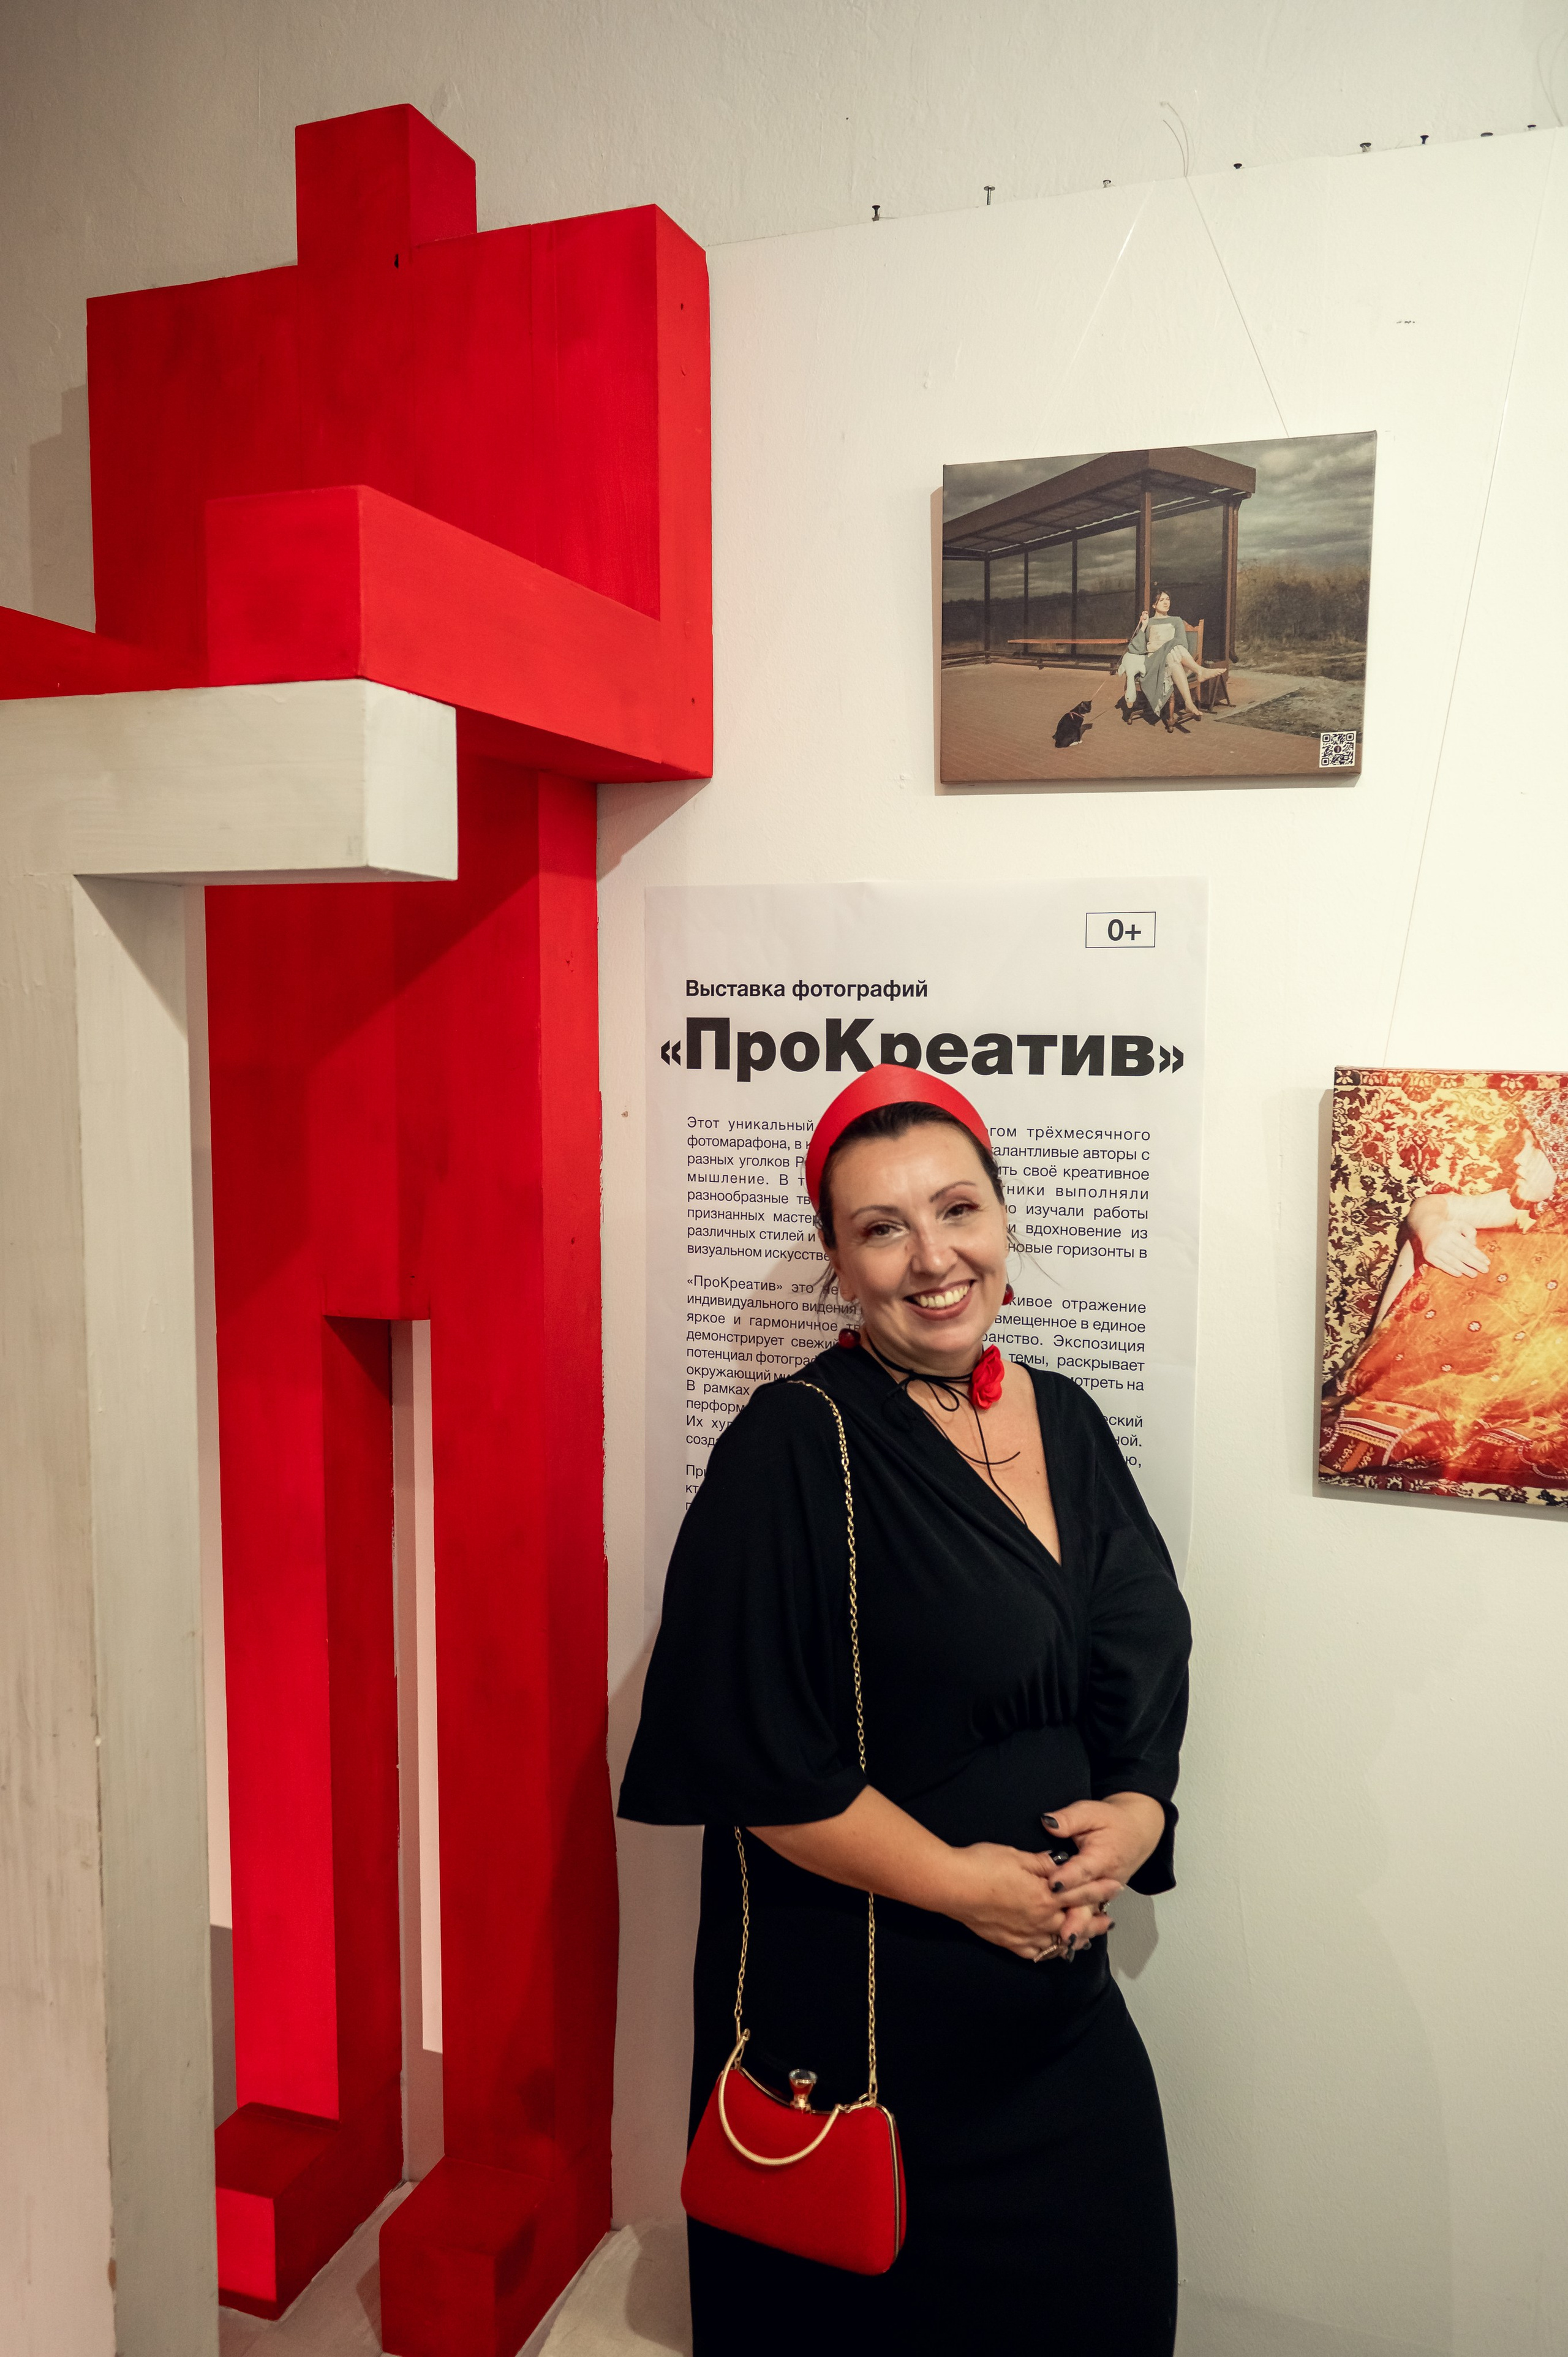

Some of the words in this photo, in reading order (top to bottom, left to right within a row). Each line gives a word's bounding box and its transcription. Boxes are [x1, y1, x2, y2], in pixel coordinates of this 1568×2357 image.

[1108, 919, 1141, 941] 0+
[687, 980, 785, 997] Выставка
[793, 980, 927, 1001] фотографий
[660, 1017, 1185, 1083] «ПроКреатив»
[688, 1117, 719, 1128] Этот
[728, 1120, 815, 1132] уникальный
[989, 1128, 1017, 1137] гом
[1027, 1126, 1150, 1141] трёхмесячного
[687, 1135, 790, 1150] фотомарафона,
[795, 1141, 802, 1149] в
[991, 1147, 1079, 1158] алантливые
[1084, 1150, 1136, 1162] авторы
[1142, 1152, 1150, 1160] с
[688, 1155, 734, 1166] разных
[739, 1157, 790, 1168] уголков
[1023, 1165, 1057, 1177] своё
[1064, 1169, 1149, 1180] креативное
[688, 1174, 768, 1185] мышление.
[780, 1174, 788, 1185] В
[1003, 1186, 1045, 1196] ники
[1056, 1188, 1148, 1199] выполняли
[688, 1191, 788, 1204] разнообразные
[1027, 1206, 1084, 1218] изучали
[1094, 1206, 1147, 1220] работы
[688, 1209, 764, 1221] признанных
[1026, 1225, 1121, 1237] вдохновение
[1132, 1229, 1147, 1239] из
[688, 1227, 755, 1239] различных
[760, 1230, 804, 1241] стилей
[1008, 1243, 1053, 1254] новые
[1057, 1245, 1134, 1258] горизонты
[1139, 1250, 1147, 1258] в
[688, 1245, 761, 1257] визуальном
[687, 1275, 782, 1291] «ПроКреатив»
[791, 1284, 813, 1294] это
[1062, 1300, 1146, 1313] отражение
[688, 1294, 799, 1310] индивидуального
[802, 1302, 856, 1314] видения
[994, 1315, 1077, 1329] вмещенное
[1081, 1320, 1088, 1329] в
[1093, 1321, 1145, 1333] единое
[687, 1313, 725, 1324] яркое
[734, 1316, 741, 1325] и
[750, 1316, 837, 1332] гармоничное
[983, 1333, 1043, 1346] анство.
[1054, 1335, 1144, 1353] Экспозиция
[687, 1330, 785, 1348] демонстрирует
[1008, 1353, 1049, 1367] темы,
[1057, 1357, 1145, 1372] раскрывает
[687, 1349, 752, 1362] потенциал
[756, 1351, 816, 1367] фотогра
[687, 1365, 772, 1382] окружающий
[1071, 1377, 1124, 1390] отреть
[1128, 1381, 1144, 1390] на
[687, 1379, 695, 1390] В
[704, 1384, 750, 1396] рамках
[687, 1400, 745, 1414] перформ
[687, 1415, 703, 1427] Их
[1104, 1415, 1144, 1428] ский
[686, 1435, 717, 1447] созд
